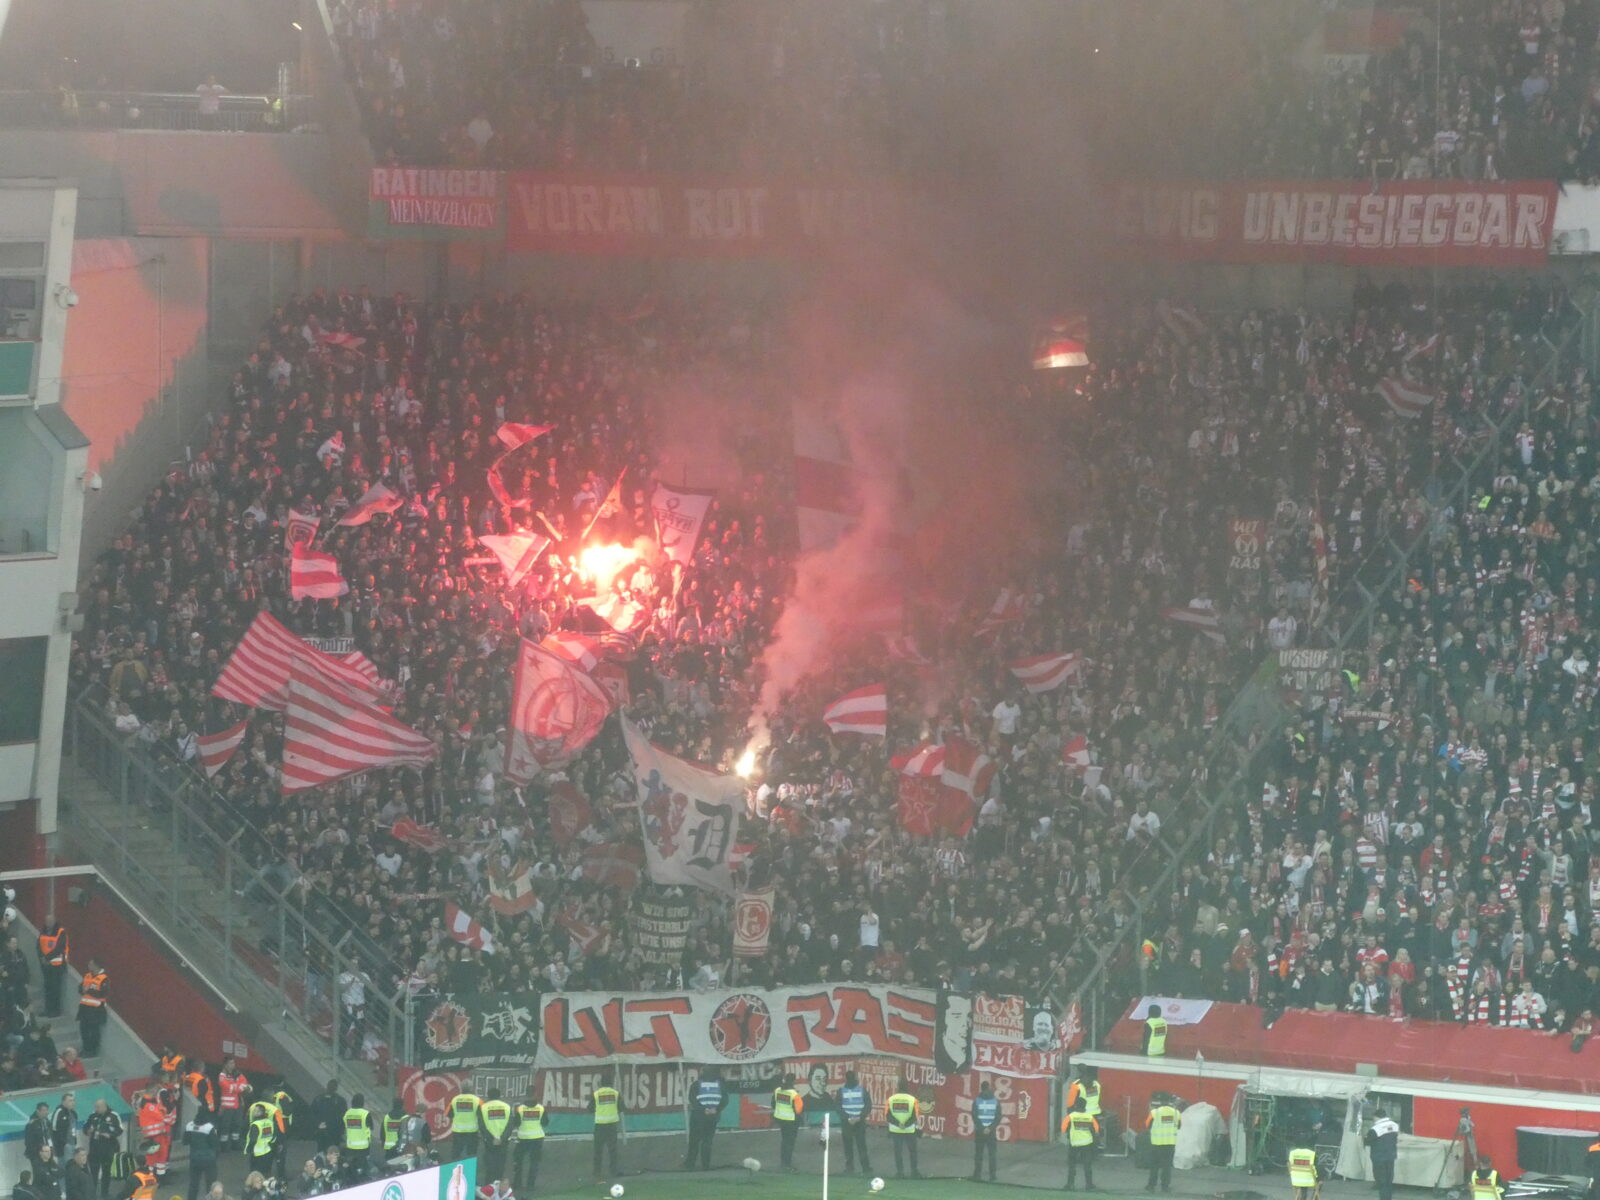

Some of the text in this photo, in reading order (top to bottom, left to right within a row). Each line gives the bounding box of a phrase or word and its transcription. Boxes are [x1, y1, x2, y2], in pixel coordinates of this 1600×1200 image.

[372, 168, 497, 196] RATINGEN
[390, 199, 496, 227] MEINERZHAGEN
[516, 184, 662, 233] VORAN
[684, 187, 769, 239] ROT
[1244, 192, 1548, 249] UNBESIEGBAR
